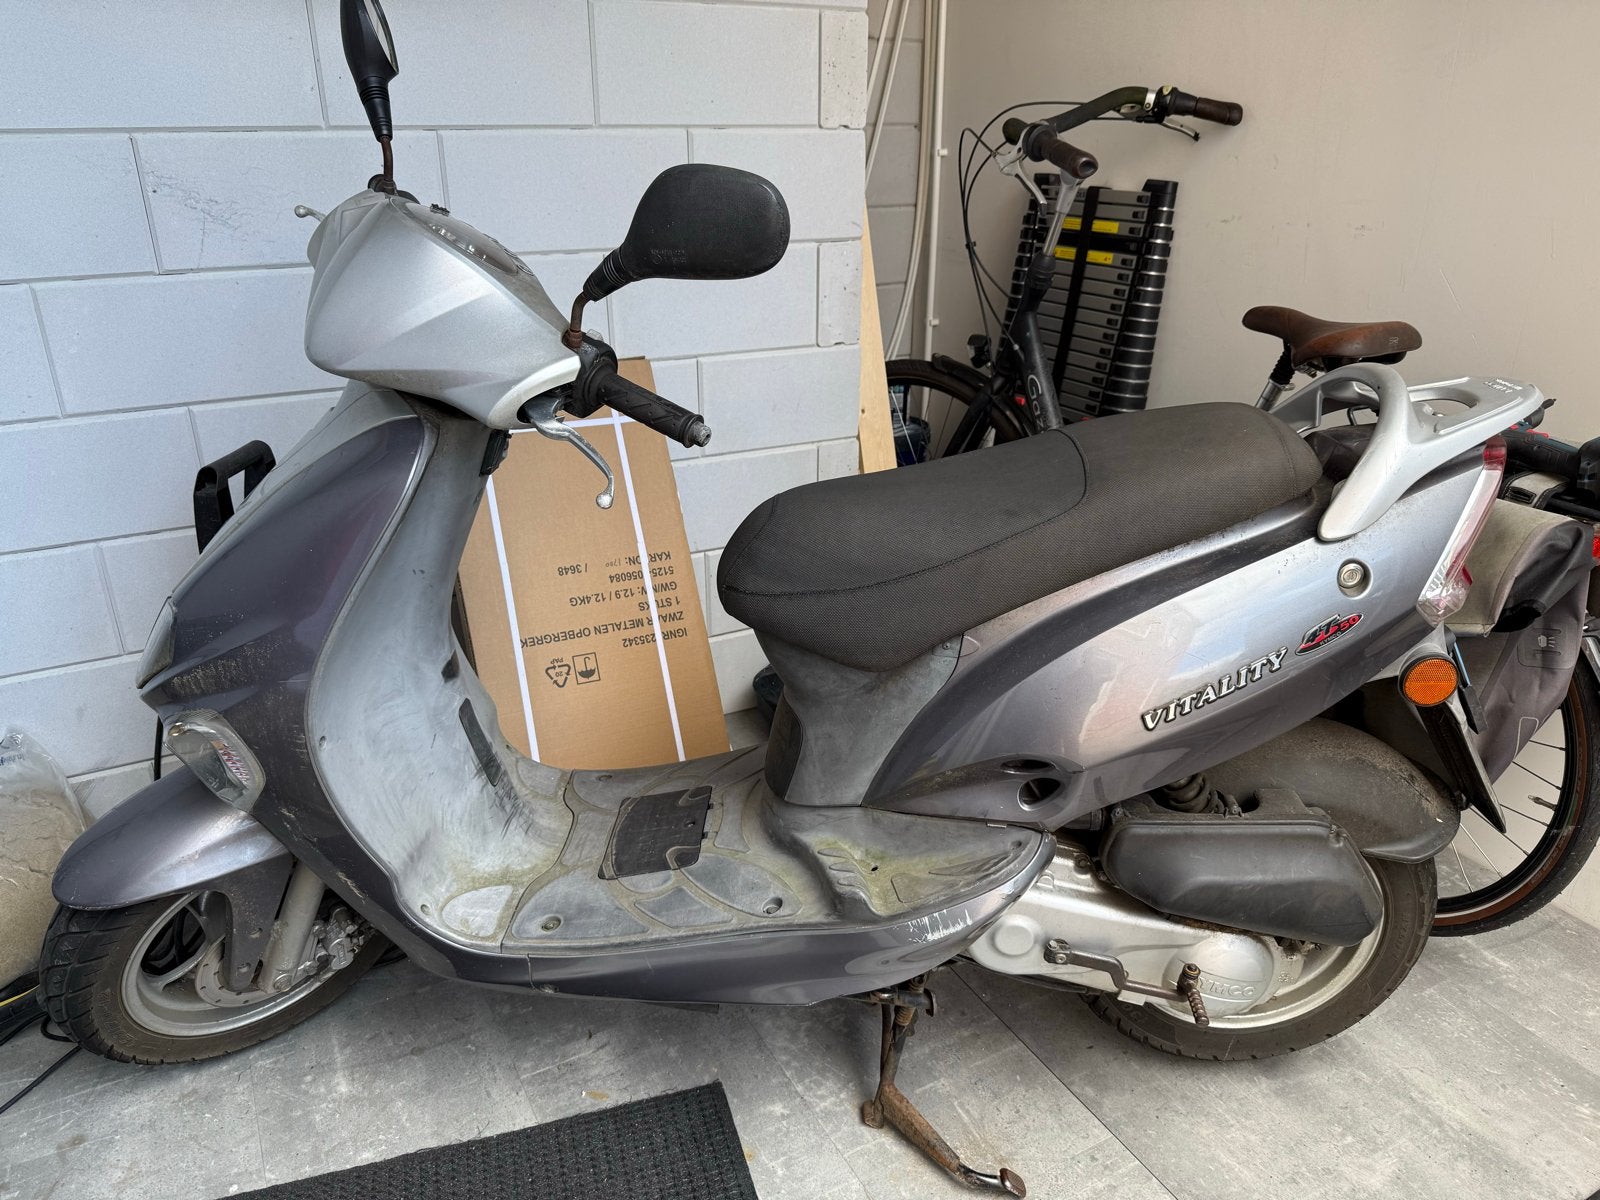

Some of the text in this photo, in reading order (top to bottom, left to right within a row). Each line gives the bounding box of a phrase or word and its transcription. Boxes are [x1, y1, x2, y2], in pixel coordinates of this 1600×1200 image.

[624, 551, 672, 567] KARON:
[557, 563, 582, 577] 3648
[569, 592, 606, 607] 12.4KG
[615, 588, 635, 599] 12.9
[594, 617, 645, 636] METALEN
[1339, 615, 1360, 631] 50
[520, 627, 591, 648] OPBERGREK
[622, 633, 656, 648] 235342
[1141, 646, 1289, 731] VITALITY
[1199, 977, 1255, 997] YMCO
